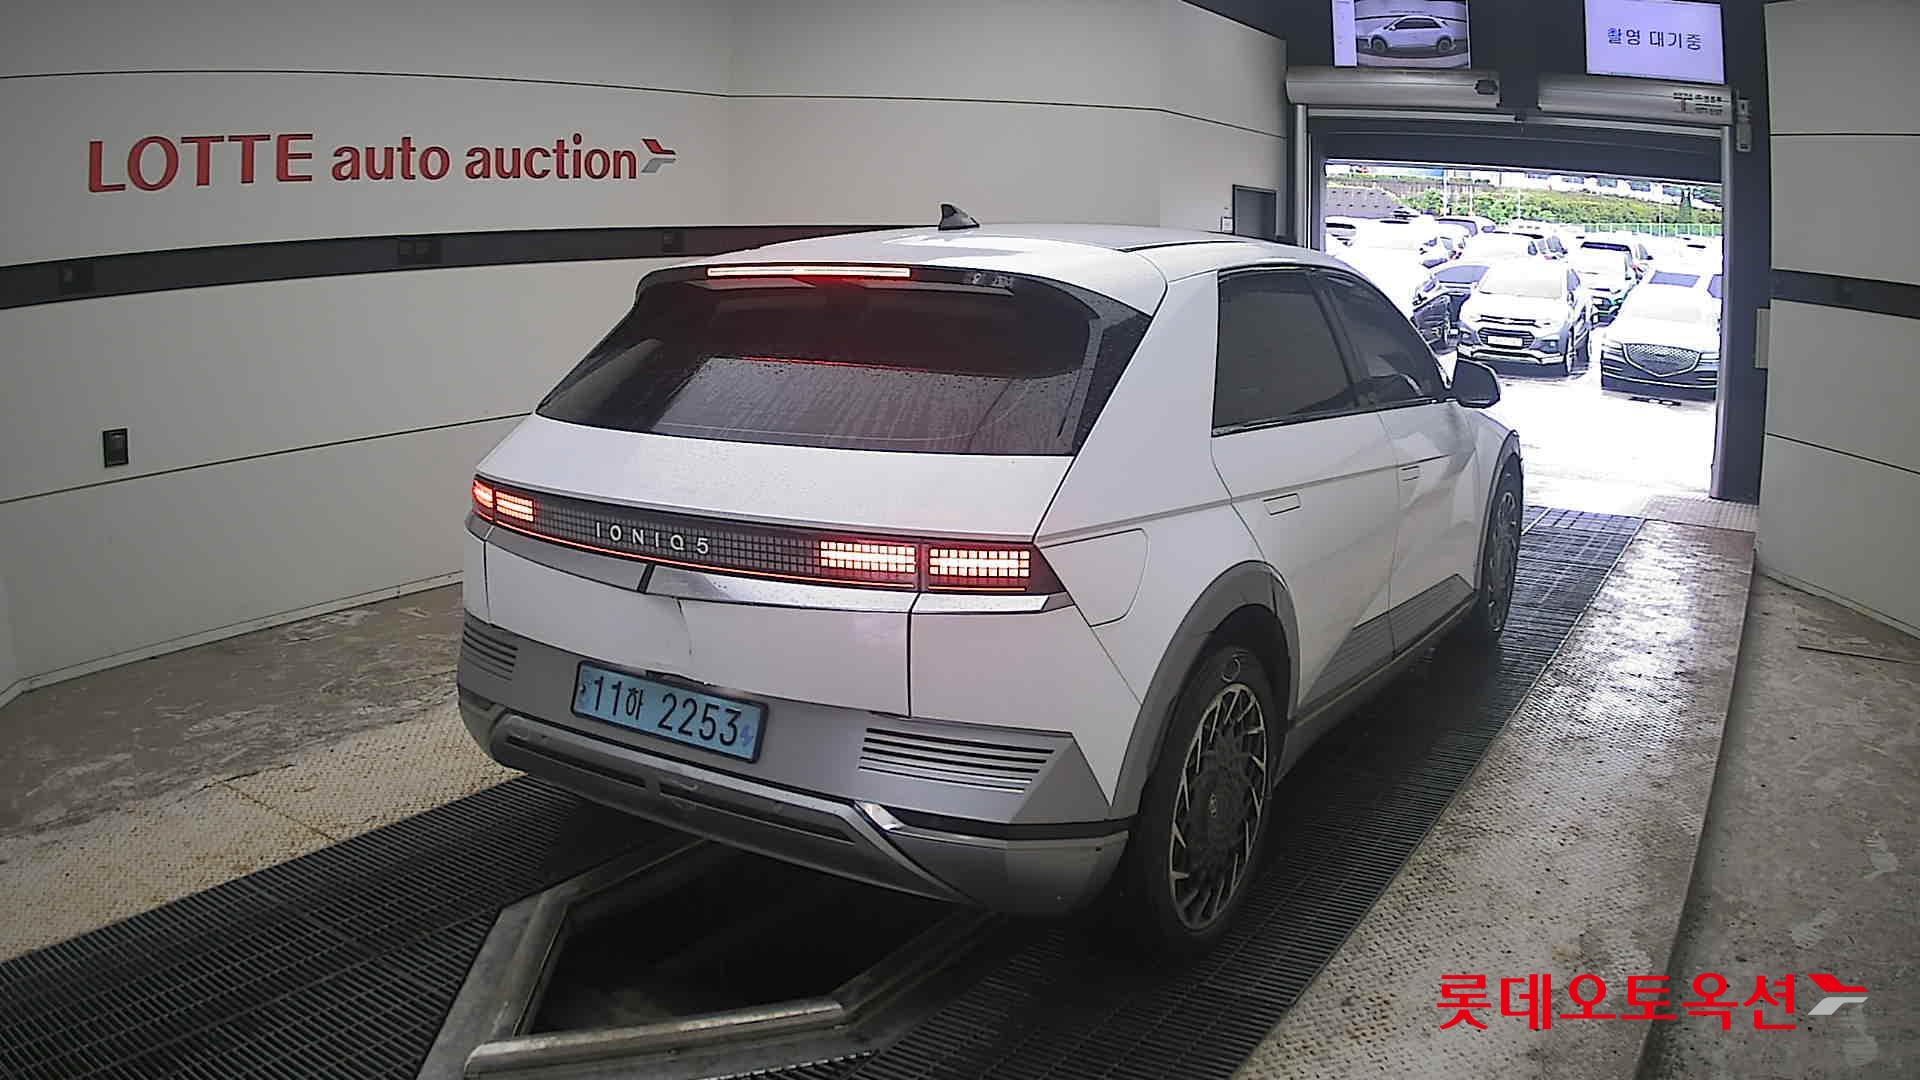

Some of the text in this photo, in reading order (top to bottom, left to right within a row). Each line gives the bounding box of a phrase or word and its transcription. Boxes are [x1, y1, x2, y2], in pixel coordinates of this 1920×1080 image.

[1608, 27, 1702, 51] 촬영 대기중
[88, 133, 638, 193] LOTTE auto auction
[657, 692, 743, 747] 2253
